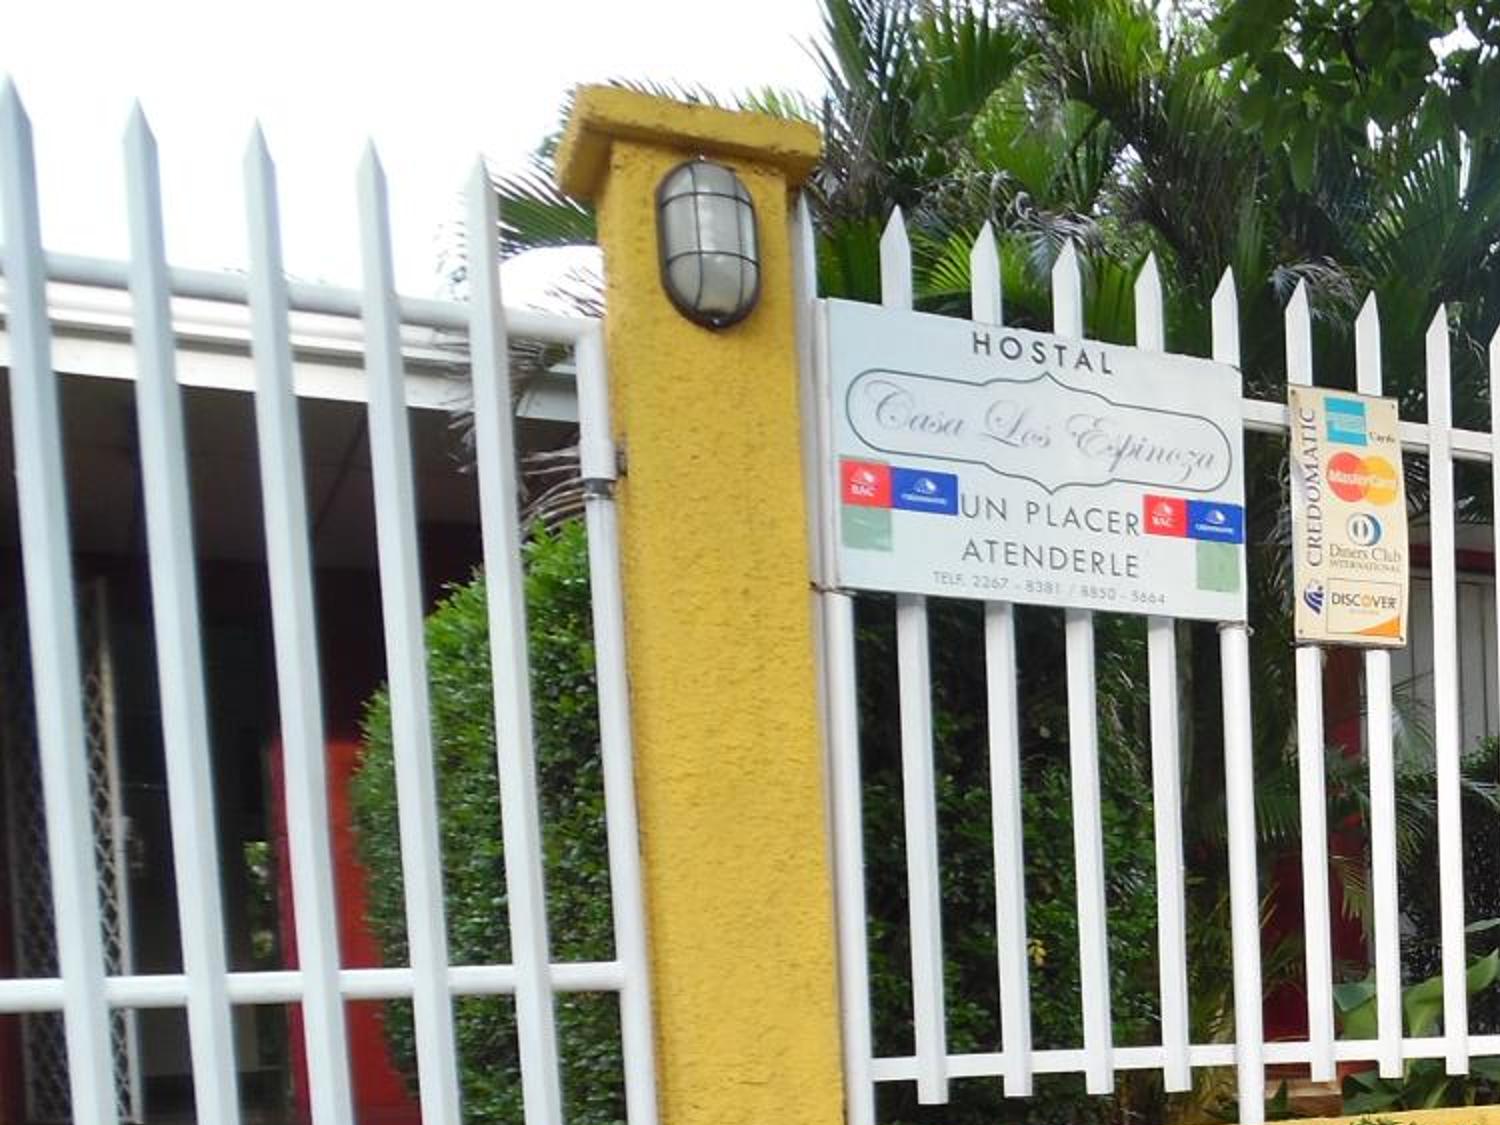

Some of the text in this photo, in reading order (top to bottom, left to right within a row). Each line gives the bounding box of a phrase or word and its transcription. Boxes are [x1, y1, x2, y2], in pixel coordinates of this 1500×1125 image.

[972, 331, 1113, 375] HOSTAL
[865, 379, 1215, 482] Casa Los Espinoza
[1301, 409, 1324, 568] CREDOMATIC
[961, 494, 1008, 521] UN
[1026, 501, 1140, 536] PLACER
[962, 538, 1140, 578] ATENDERLE
[1330, 544, 1401, 563] Diners Club
[973, 576, 1009, 589] 2267
[1331, 592, 1397, 609] DISCOVER
